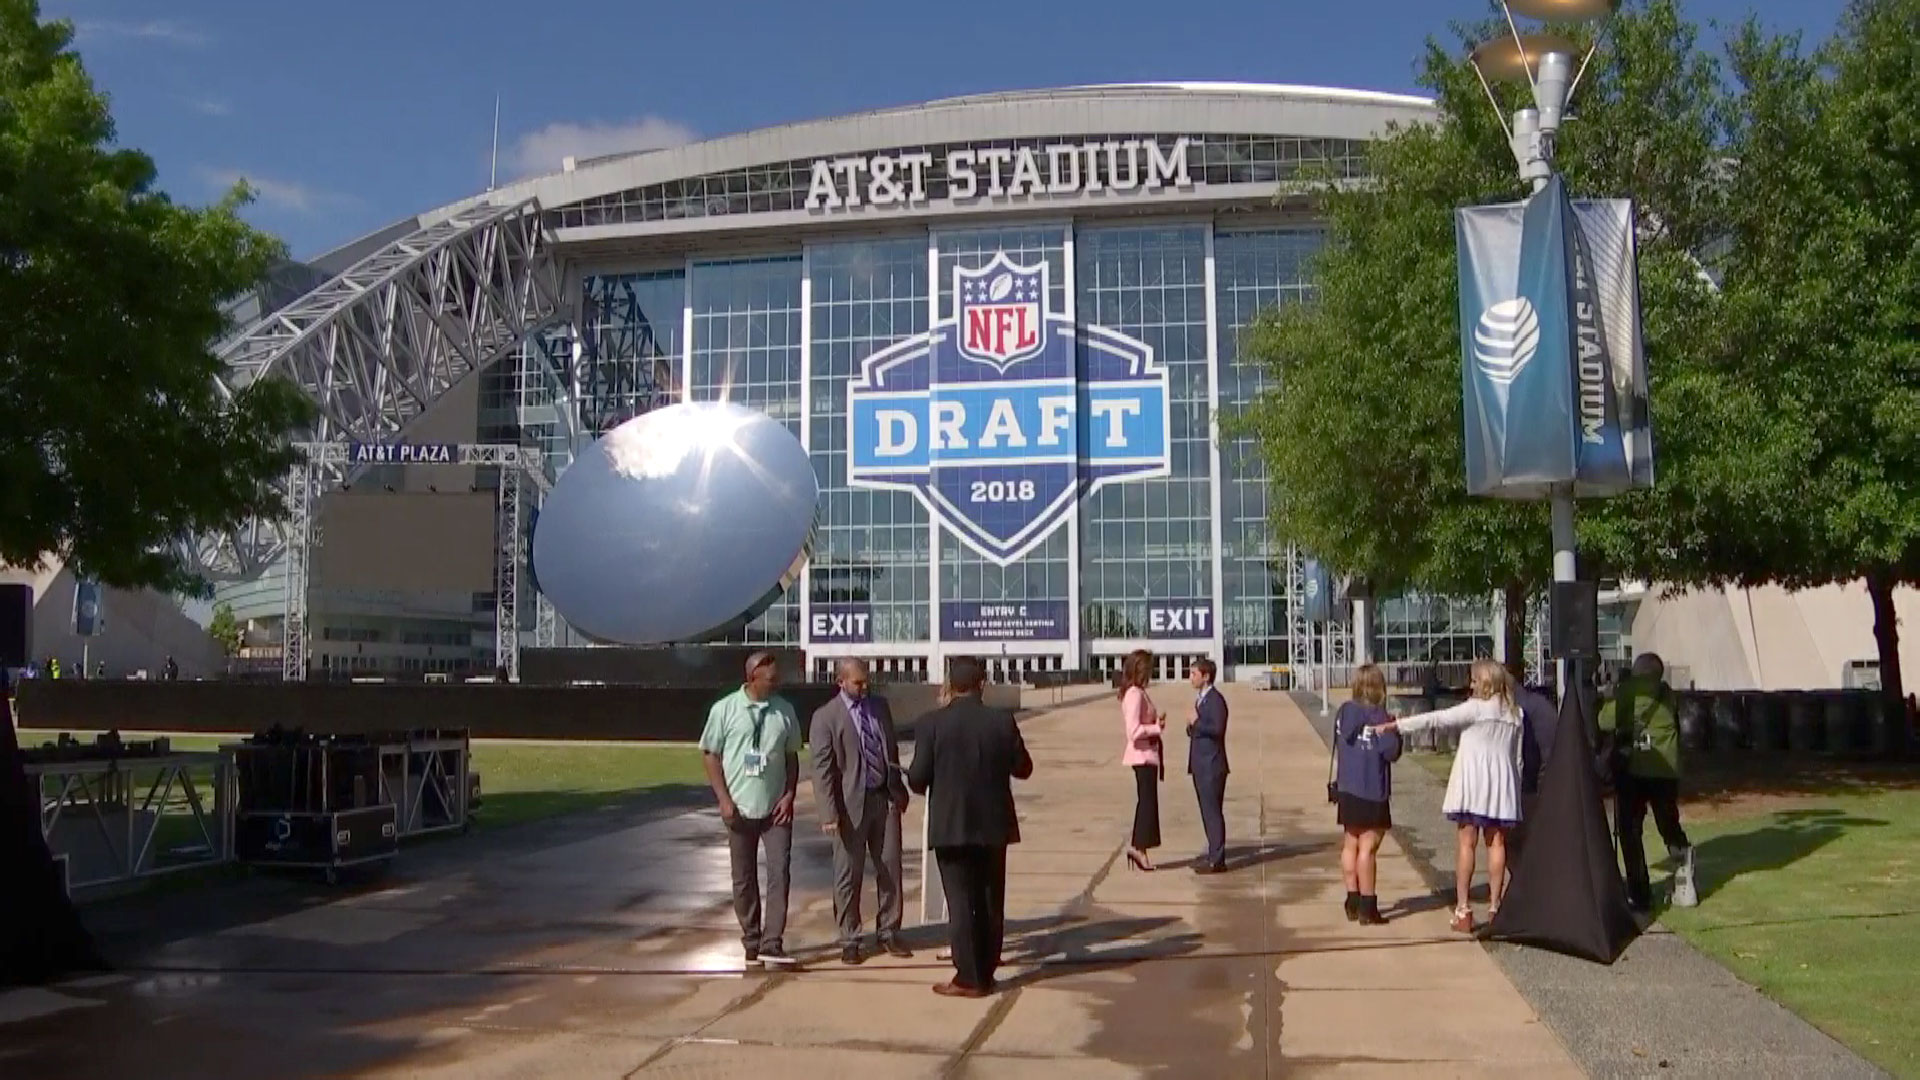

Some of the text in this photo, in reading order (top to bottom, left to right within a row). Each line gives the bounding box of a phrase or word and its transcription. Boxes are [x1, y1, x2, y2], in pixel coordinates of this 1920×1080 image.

[804, 137, 1191, 209] AT&T STADIUM
[967, 306, 1036, 356] NFL
[1576, 302, 1604, 445] STADIUM
[874, 395, 1140, 457] DRAFT
[357, 444, 450, 461] AT&T PLAZA
[970, 480, 1036, 502] 2018
[980, 605, 1014, 617] ENTRY
[1150, 607, 1209, 631] EXIT
[812, 613, 869, 636] EXIT
